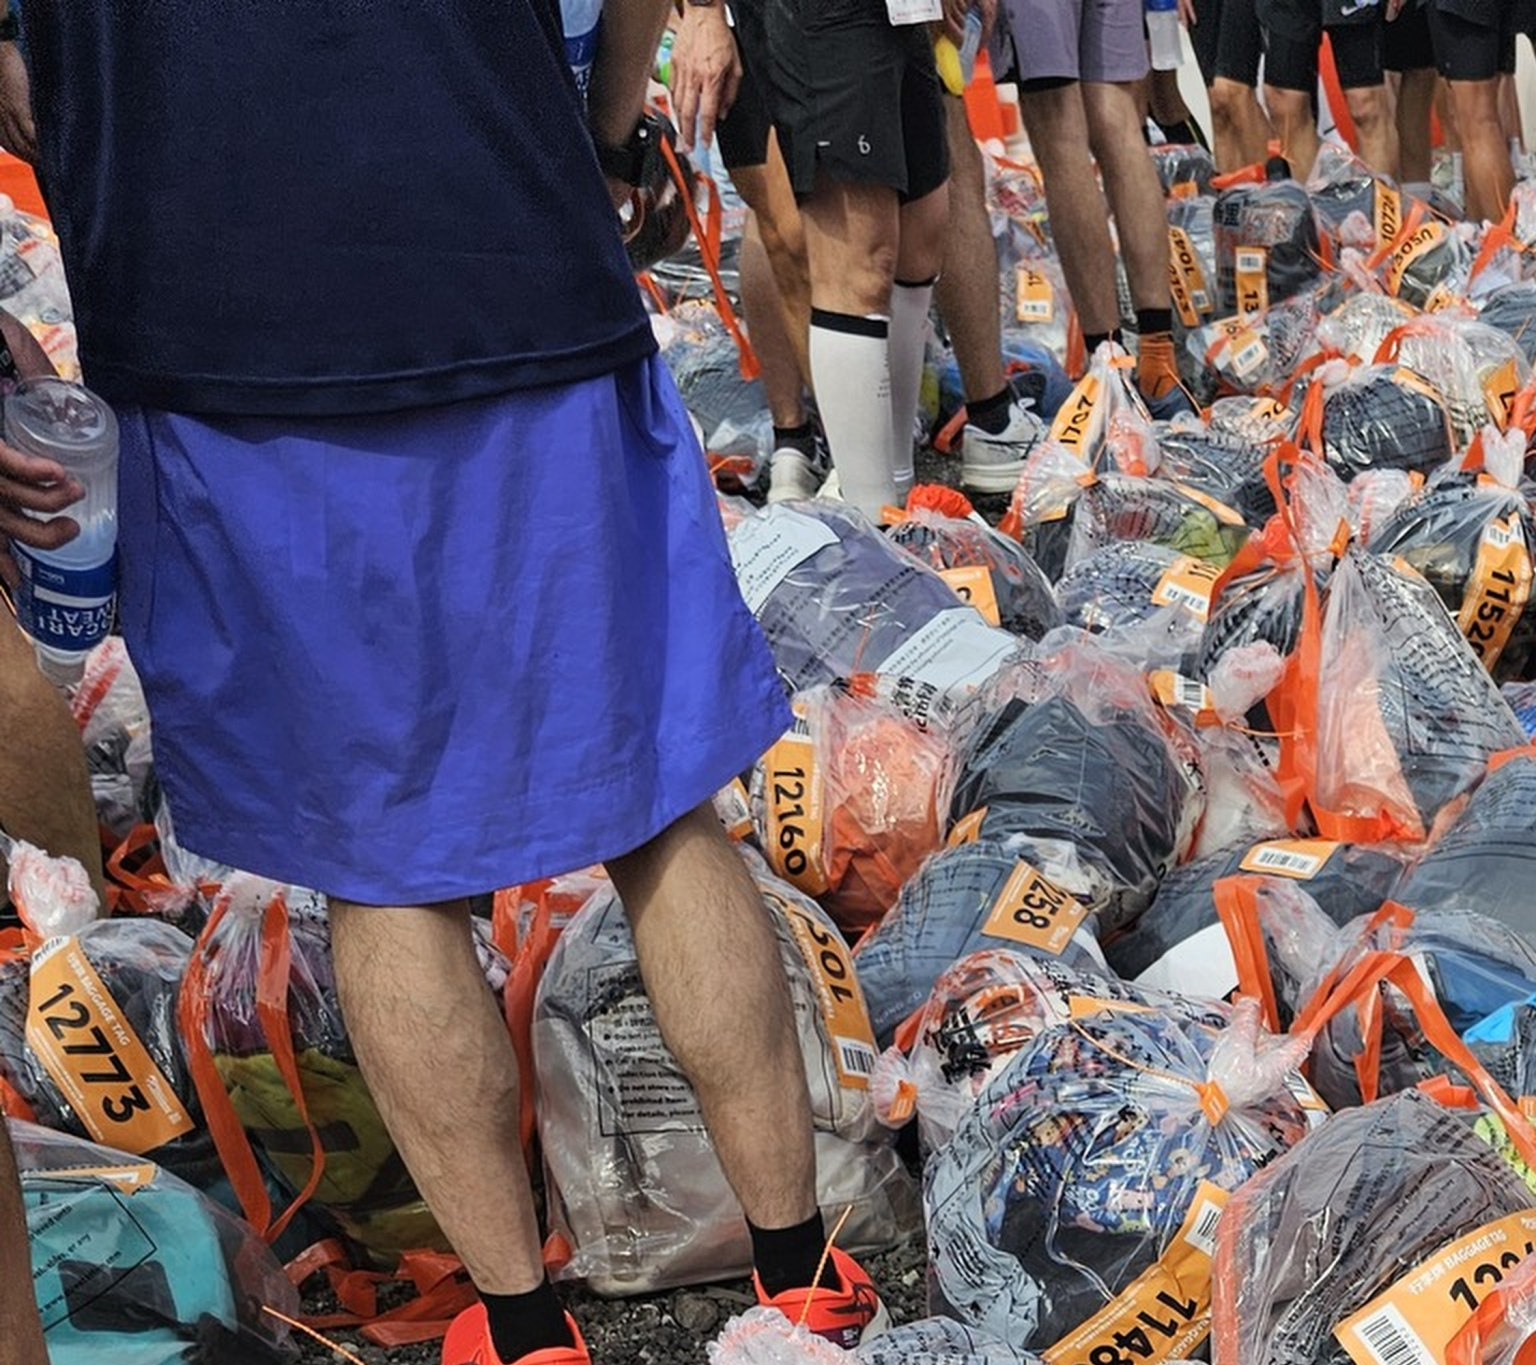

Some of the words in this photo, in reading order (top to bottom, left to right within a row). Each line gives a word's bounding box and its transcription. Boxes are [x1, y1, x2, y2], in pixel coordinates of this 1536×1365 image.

[773, 767, 808, 877] 12160
[37, 983, 152, 1124] 12773
[78, 972, 117, 1026] BAGGAGE
[110, 1022, 131, 1047] TAG
[1442, 1236, 1490, 1270] BAGGAGE
[1488, 1228, 1508, 1248] TAG
